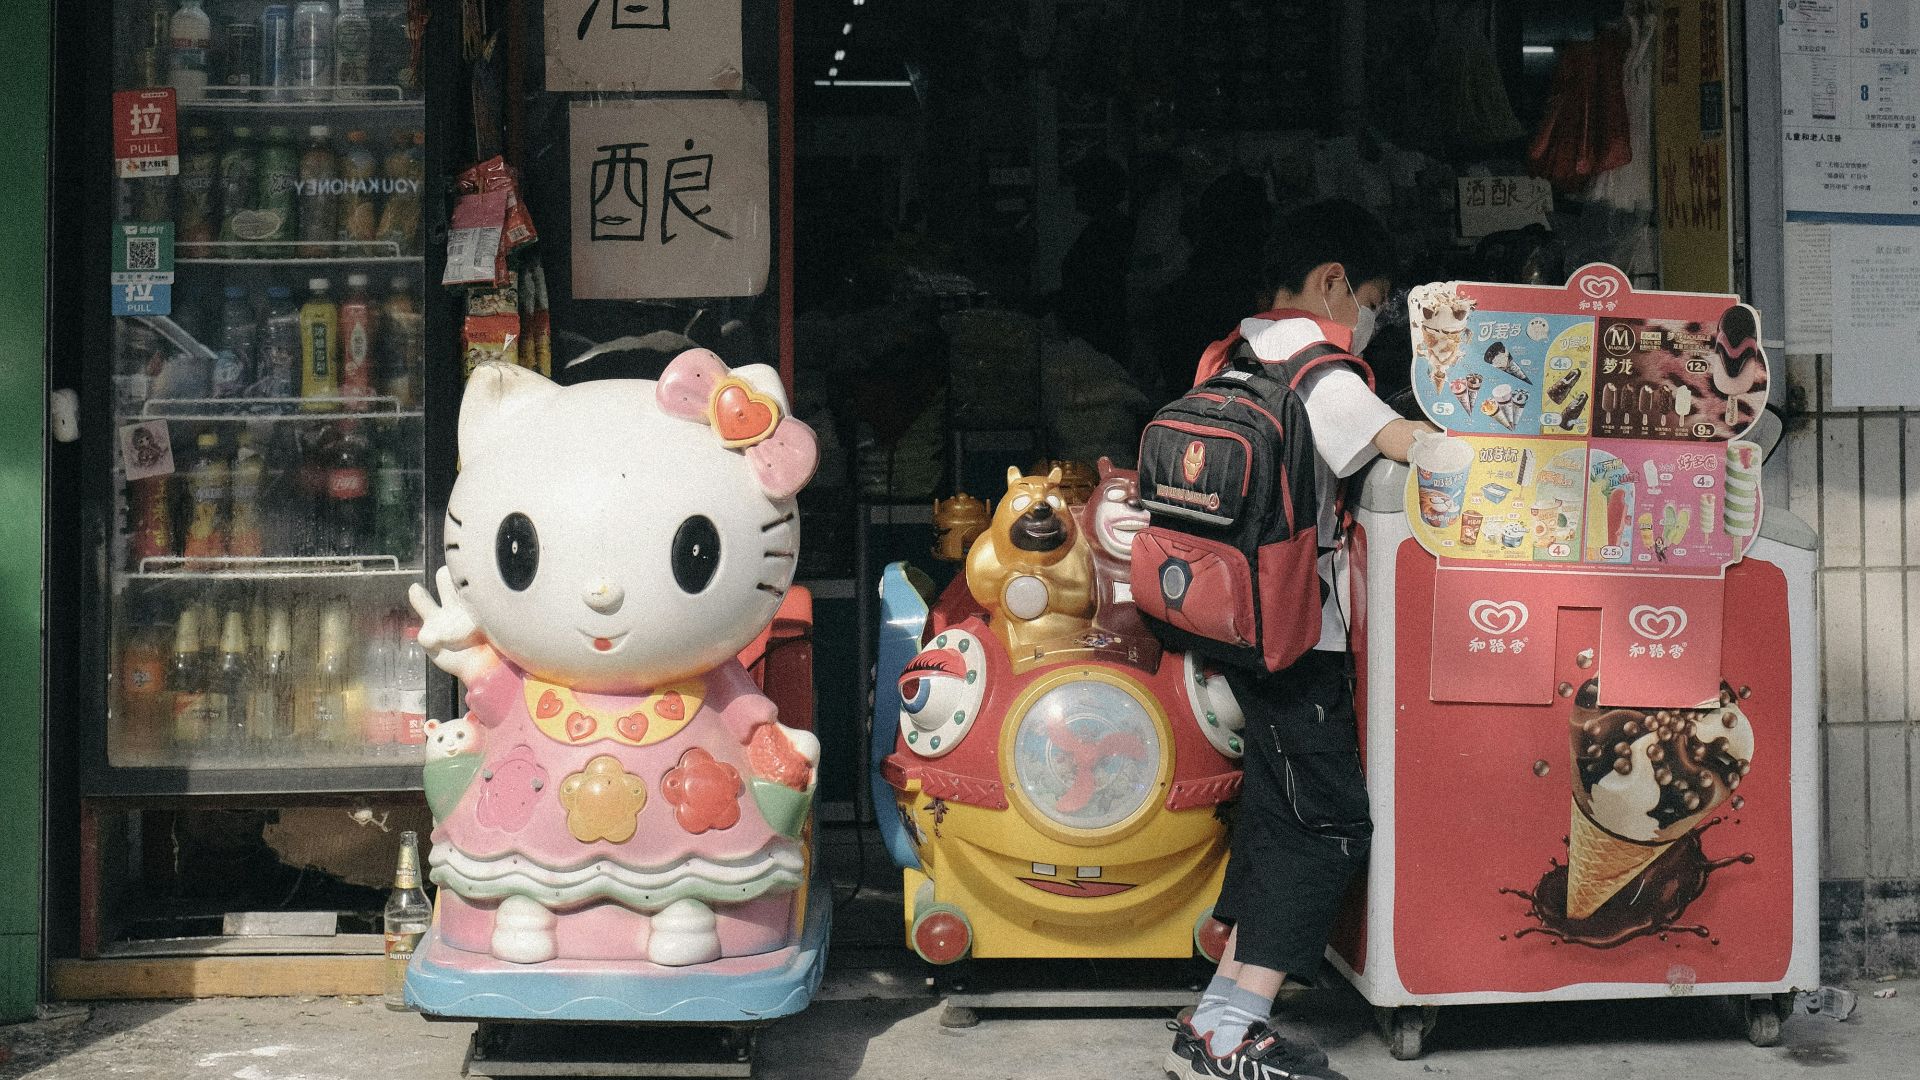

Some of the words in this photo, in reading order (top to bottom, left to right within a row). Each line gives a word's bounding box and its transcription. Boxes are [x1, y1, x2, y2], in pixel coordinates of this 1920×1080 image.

[1859, 12, 1869, 29] 5
[1861, 84, 1869, 101] 8
[130, 103, 163, 136] 拉
[1785, 132, 1842, 142] 儿童和老人注册
[130, 143, 162, 154] PULL
[590, 138, 735, 245] 酿
[1478, 321, 1521, 341] 可爱多
[1602, 357, 1633, 375] 梦龙
[1479, 447, 1519, 463] 奶昔杯
